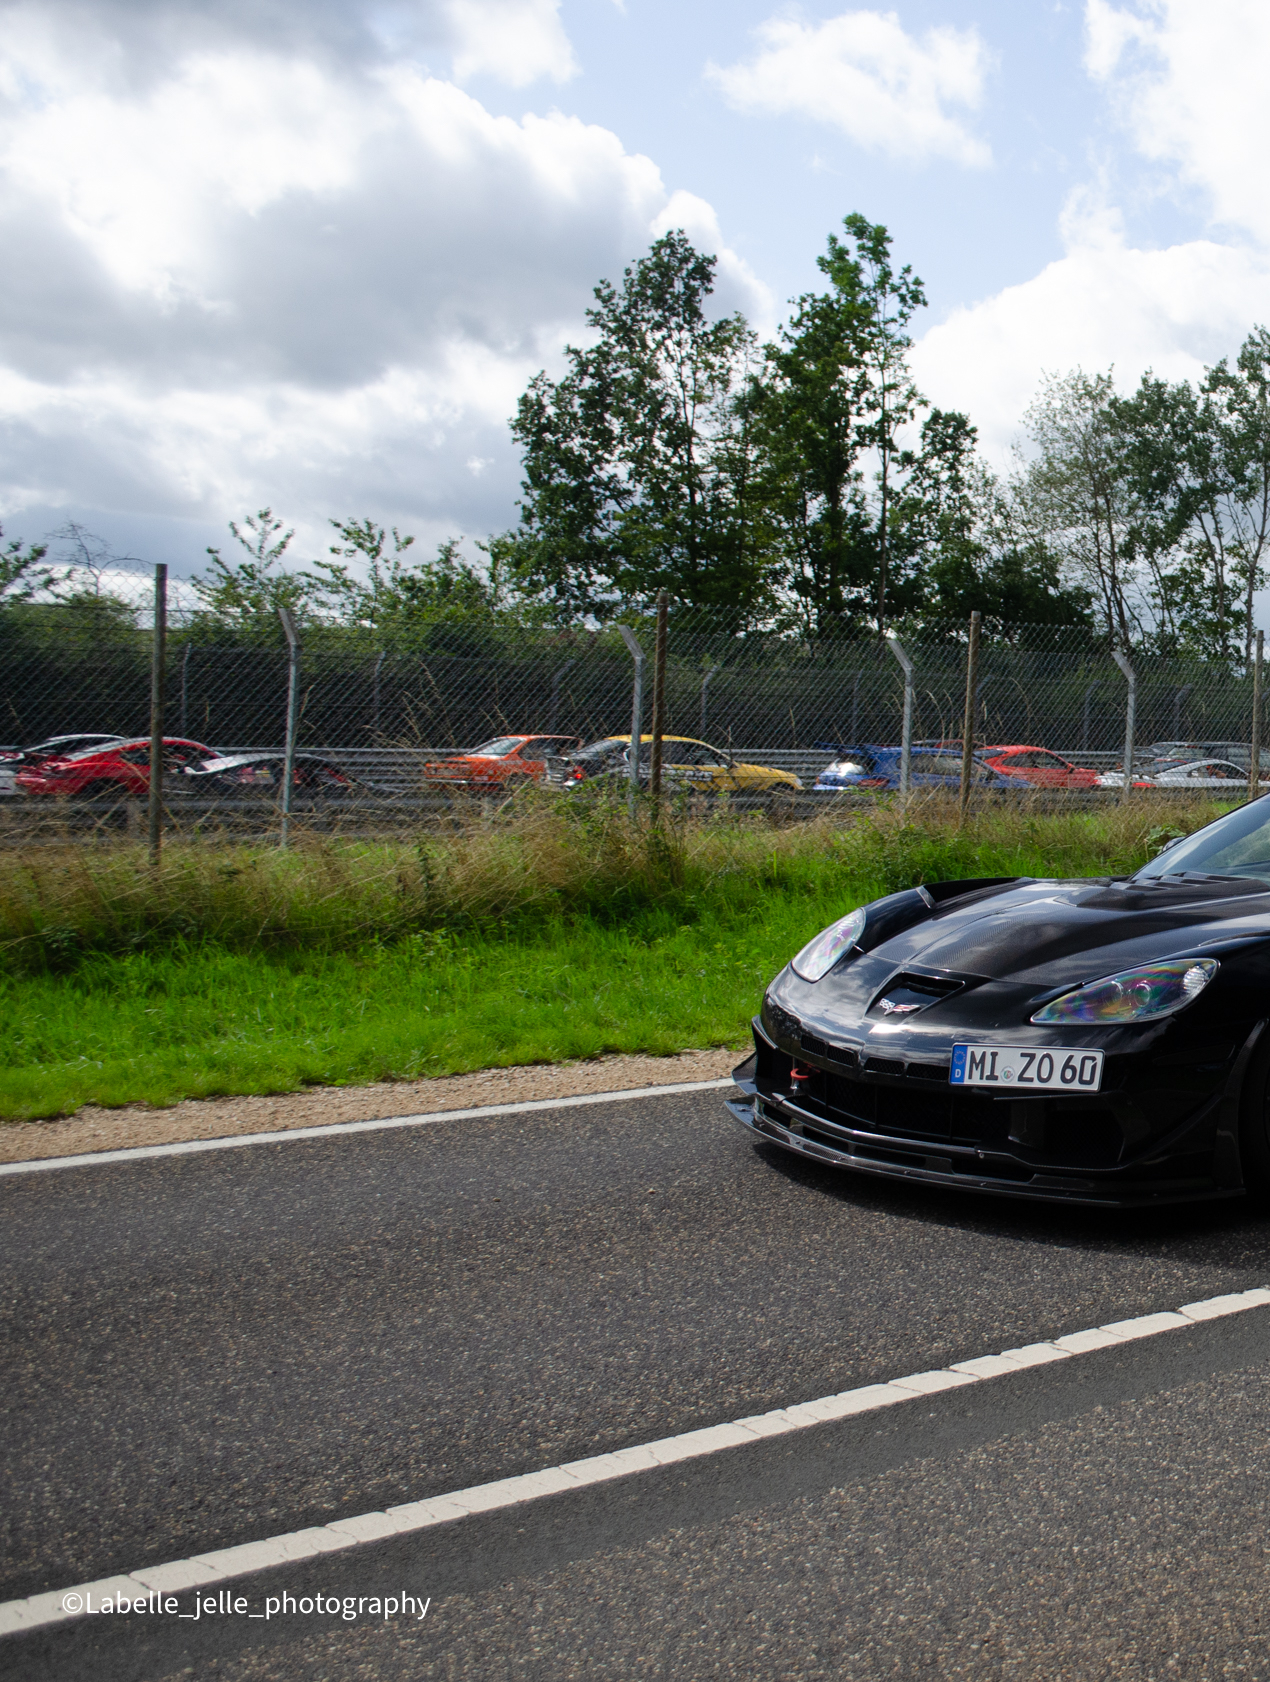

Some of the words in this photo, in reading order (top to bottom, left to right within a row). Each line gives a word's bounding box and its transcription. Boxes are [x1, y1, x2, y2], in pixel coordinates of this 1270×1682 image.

[954, 1069, 961, 1078] D
[968, 1050, 999, 1081] MI
[1017, 1051, 1054, 1083] ZO
[1060, 1054, 1097, 1086] 60
